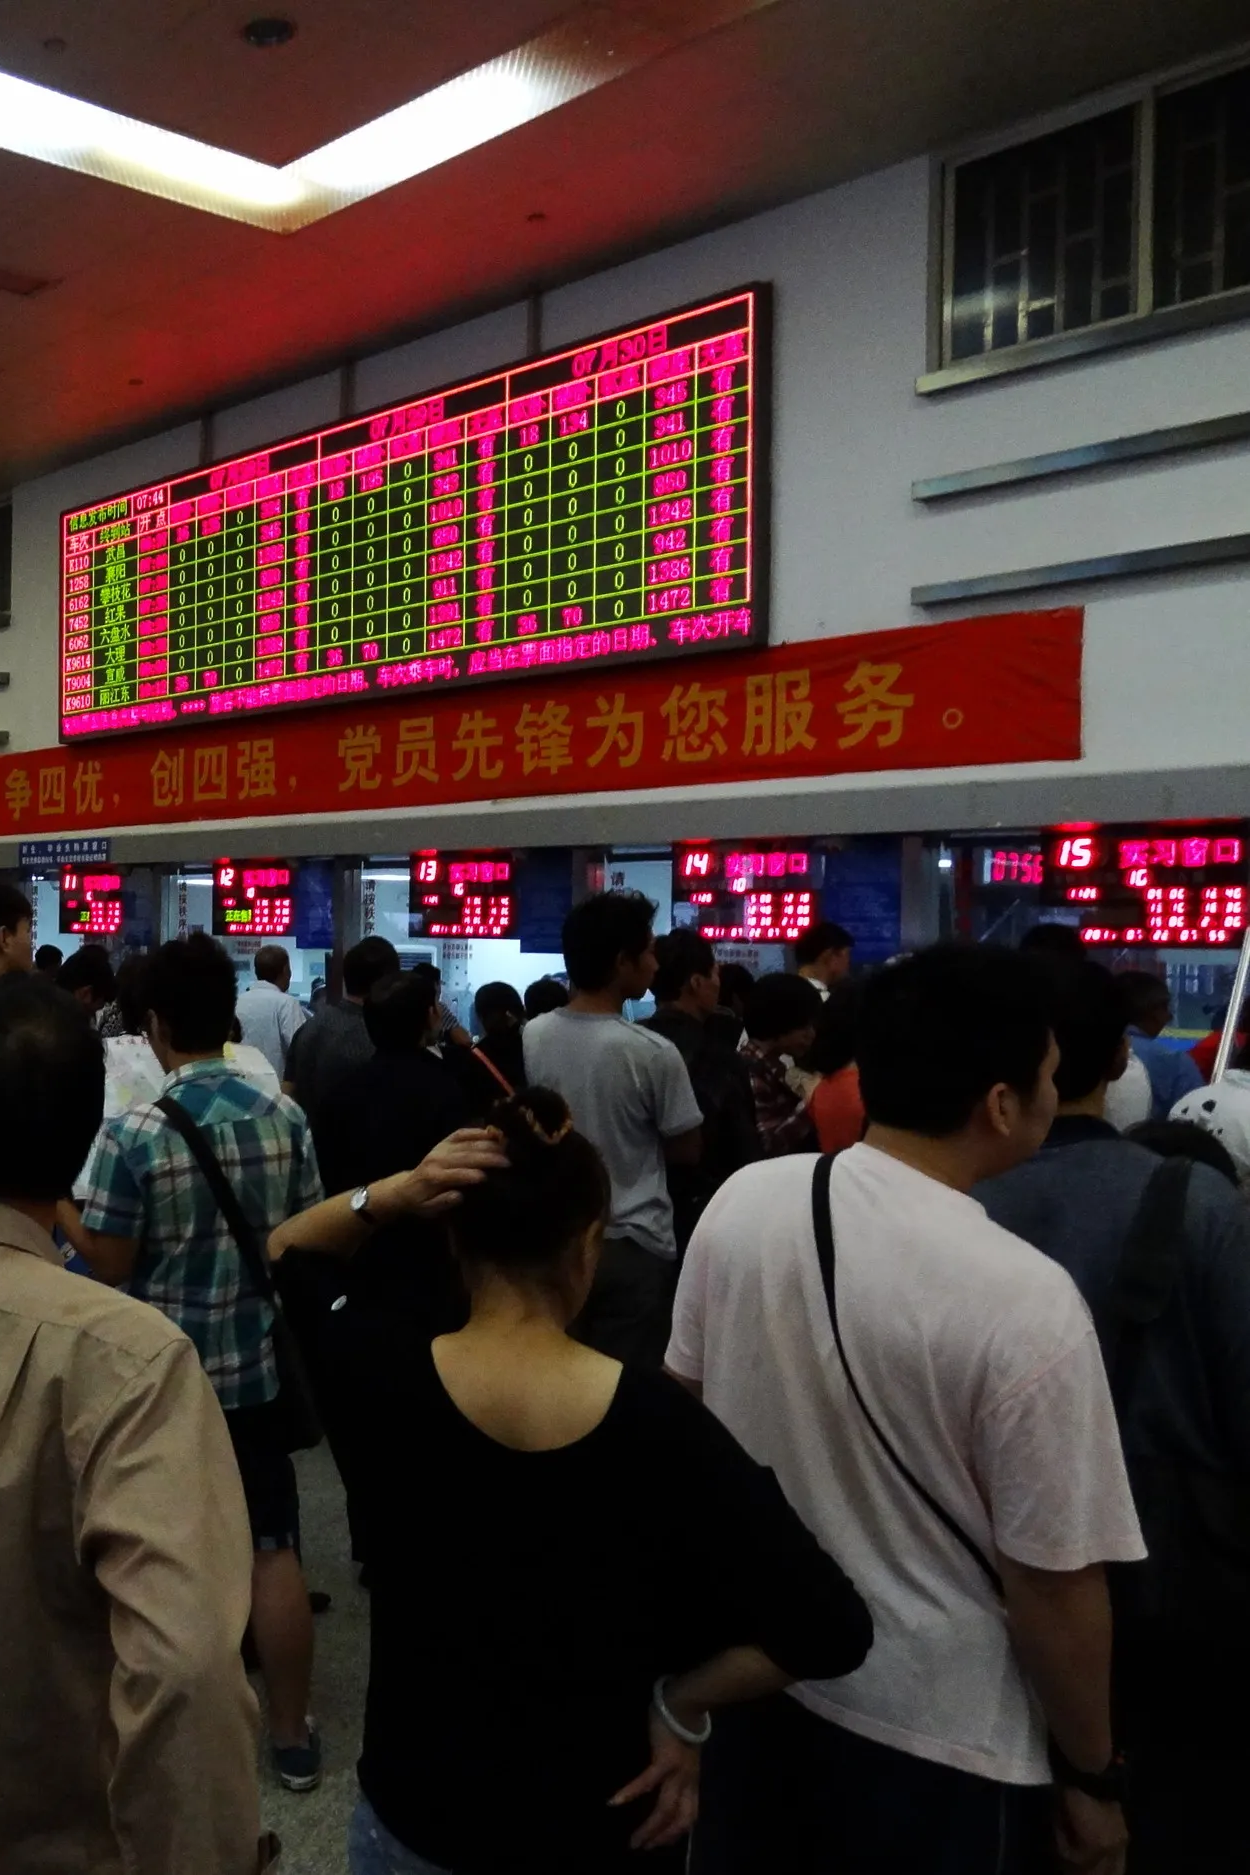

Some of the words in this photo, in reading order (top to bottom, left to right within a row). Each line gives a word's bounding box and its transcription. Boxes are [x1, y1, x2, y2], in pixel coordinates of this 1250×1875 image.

[69, 554, 89, 572] K110
[105, 542, 126, 563] 武昌
[237, 510, 243, 524] 0
[404, 462, 411, 478] 0
[519, 423, 539, 447] 18
[616, 400, 625, 419] 0
[654, 380, 688, 409] 345
[710, 365, 736, 393] 有
[136, 489, 163, 511] 07:44
[572, 325, 667, 379] 07月30日
[69, 574, 89, 592] 1258
[179, 548, 185, 562] 0
[207, 541, 214, 555] 0
[236, 533, 243, 547] 0
[332, 506, 339, 522] 0
[367, 497, 374, 513] 0
[403, 487, 411, 504] 0
[524, 454, 533, 472] 0
[569, 441, 577, 460] 0
[616, 428, 625, 447] 0
[711, 395, 735, 422] 有
[69, 594, 89, 611] 6162
[179, 570, 185, 584] 0
[207, 562, 214, 576] 0
[236, 555, 243, 569] 0
[332, 530, 339, 546] 0
[367, 522, 374, 537] 0
[403, 512, 411, 528] 0
[429, 497, 463, 523] 1010
[524, 481, 533, 499] 0
[568, 469, 577, 488] 0
[615, 457, 625, 476] 0
[649, 438, 692, 468] 1010
[710, 424, 735, 452] 有
[69, 614, 89, 631] 7452
[104, 604, 126, 624] 红果
[179, 591, 185, 605] 0
[207, 584, 213, 599] 0
[236, 577, 243, 591] 0
[331, 554, 339, 569] 0
[367, 546, 374, 562] 0
[403, 537, 411, 553] 0
[523, 508, 532, 526] 0
[568, 497, 577, 515] 0
[615, 486, 624, 504] 0
[653, 469, 687, 496] 850
[710, 455, 735, 482] 有
[69, 533, 88, 554] 车次
[65, 673, 91, 691] T9004
[179, 655, 184, 669] 0
[207, 650, 213, 664] 0
[236, 645, 242, 659] 0
[331, 626, 338, 642] 0
[366, 619, 374, 635] 0
[403, 612, 410, 628] 0
[523, 589, 531, 606] 0
[567, 580, 576, 599] 0
[614, 571, 624, 589] 0
[647, 556, 690, 584] 1386
[709, 545, 734, 572] 有
[66, 654, 91, 672] K9614
[104, 644, 126, 664] 大理
[179, 634, 185, 647] 0
[207, 628, 213, 642] 0
[236, 622, 242, 636] 0
[331, 602, 338, 617] 0
[366, 595, 374, 611] 0
[403, 587, 410, 603] 0
[432, 576, 457, 598] 911
[523, 562, 532, 580] 0
[568, 552, 576, 570] 0
[615, 542, 624, 561] 0
[652, 527, 686, 554] 942
[709, 515, 734, 542] 有
[68, 634, 88, 651] 6062
[99, 622, 131, 645] 六盘水
[179, 612, 185, 626] 0
[207, 606, 213, 620] 0
[236, 600, 243, 614] 0
[331, 578, 339, 594] 0
[367, 570, 374, 586] 0
[403, 562, 410, 578] 0
[428, 549, 462, 574] 1242
[523, 535, 532, 552] 0
[568, 525, 576, 543] 0
[615, 514, 624, 533] 0
[648, 497, 691, 526] 1242
[710, 485, 734, 512] 有
[65, 694, 90, 710] K9610
[99, 684, 130, 706] 丽江东
[235, 667, 242, 681] 0
[361, 641, 379, 661] 70
[402, 637, 410, 653] 0
[428, 626, 461, 650] 1472
[561, 606, 582, 628] 70
[614, 599, 624, 618] 0
[647, 586, 690, 613] 1472
[709, 575, 733, 602] 有
[64, 874, 77, 889] 11
[220, 867, 235, 887] 12
[419, 860, 437, 881] 13
[685, 853, 709, 875] 14
[1059, 838, 1092, 867] 15
[1118, 838, 1241, 868] 实习窗口
